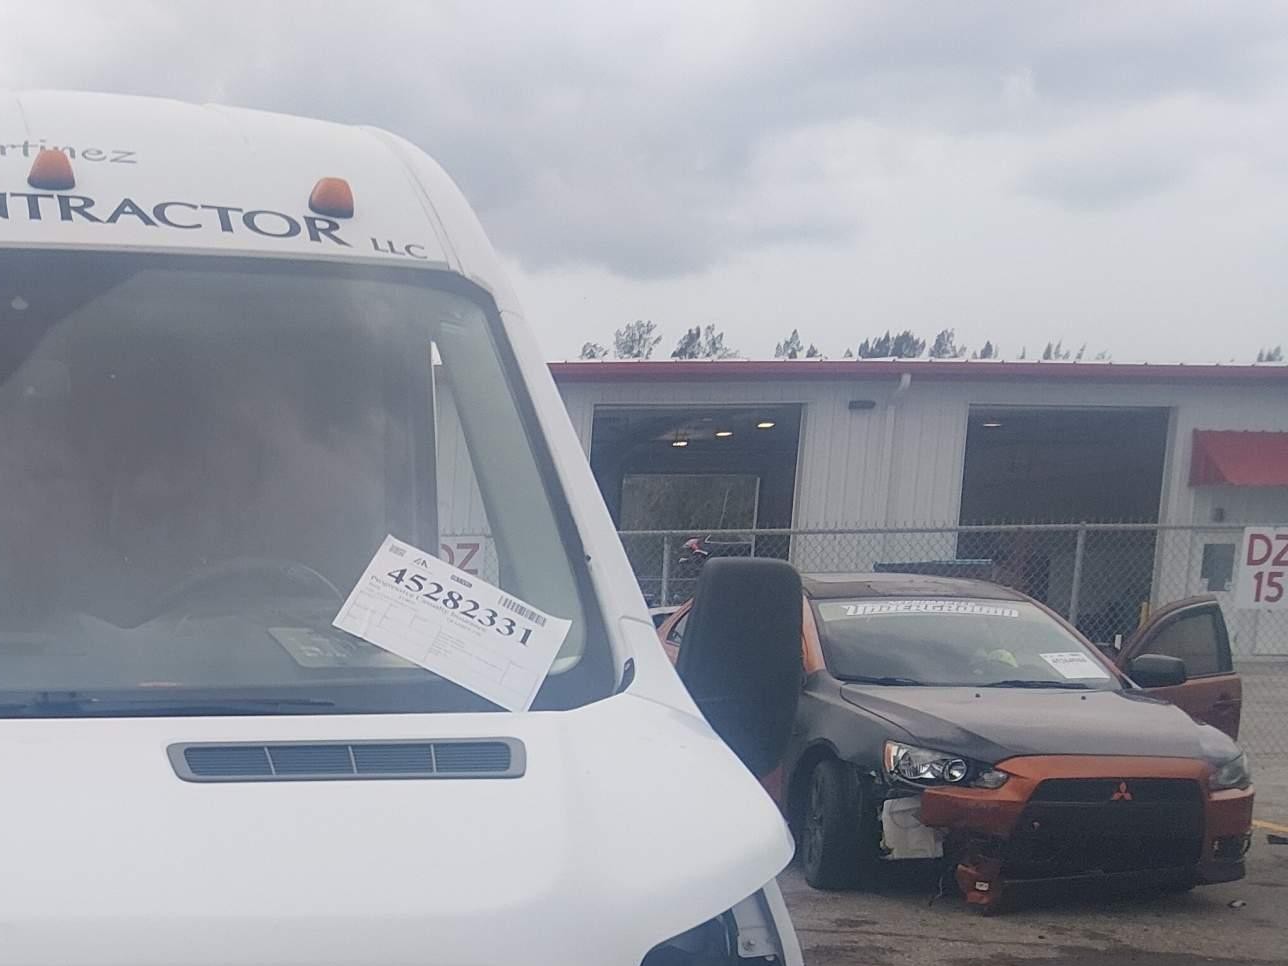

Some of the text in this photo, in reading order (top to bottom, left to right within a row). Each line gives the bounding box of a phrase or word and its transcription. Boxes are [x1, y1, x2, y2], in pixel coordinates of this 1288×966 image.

[370, 237, 428, 260] LLC
[1253, 571, 1284, 602] 15
[387, 567, 533, 647] 45282331
